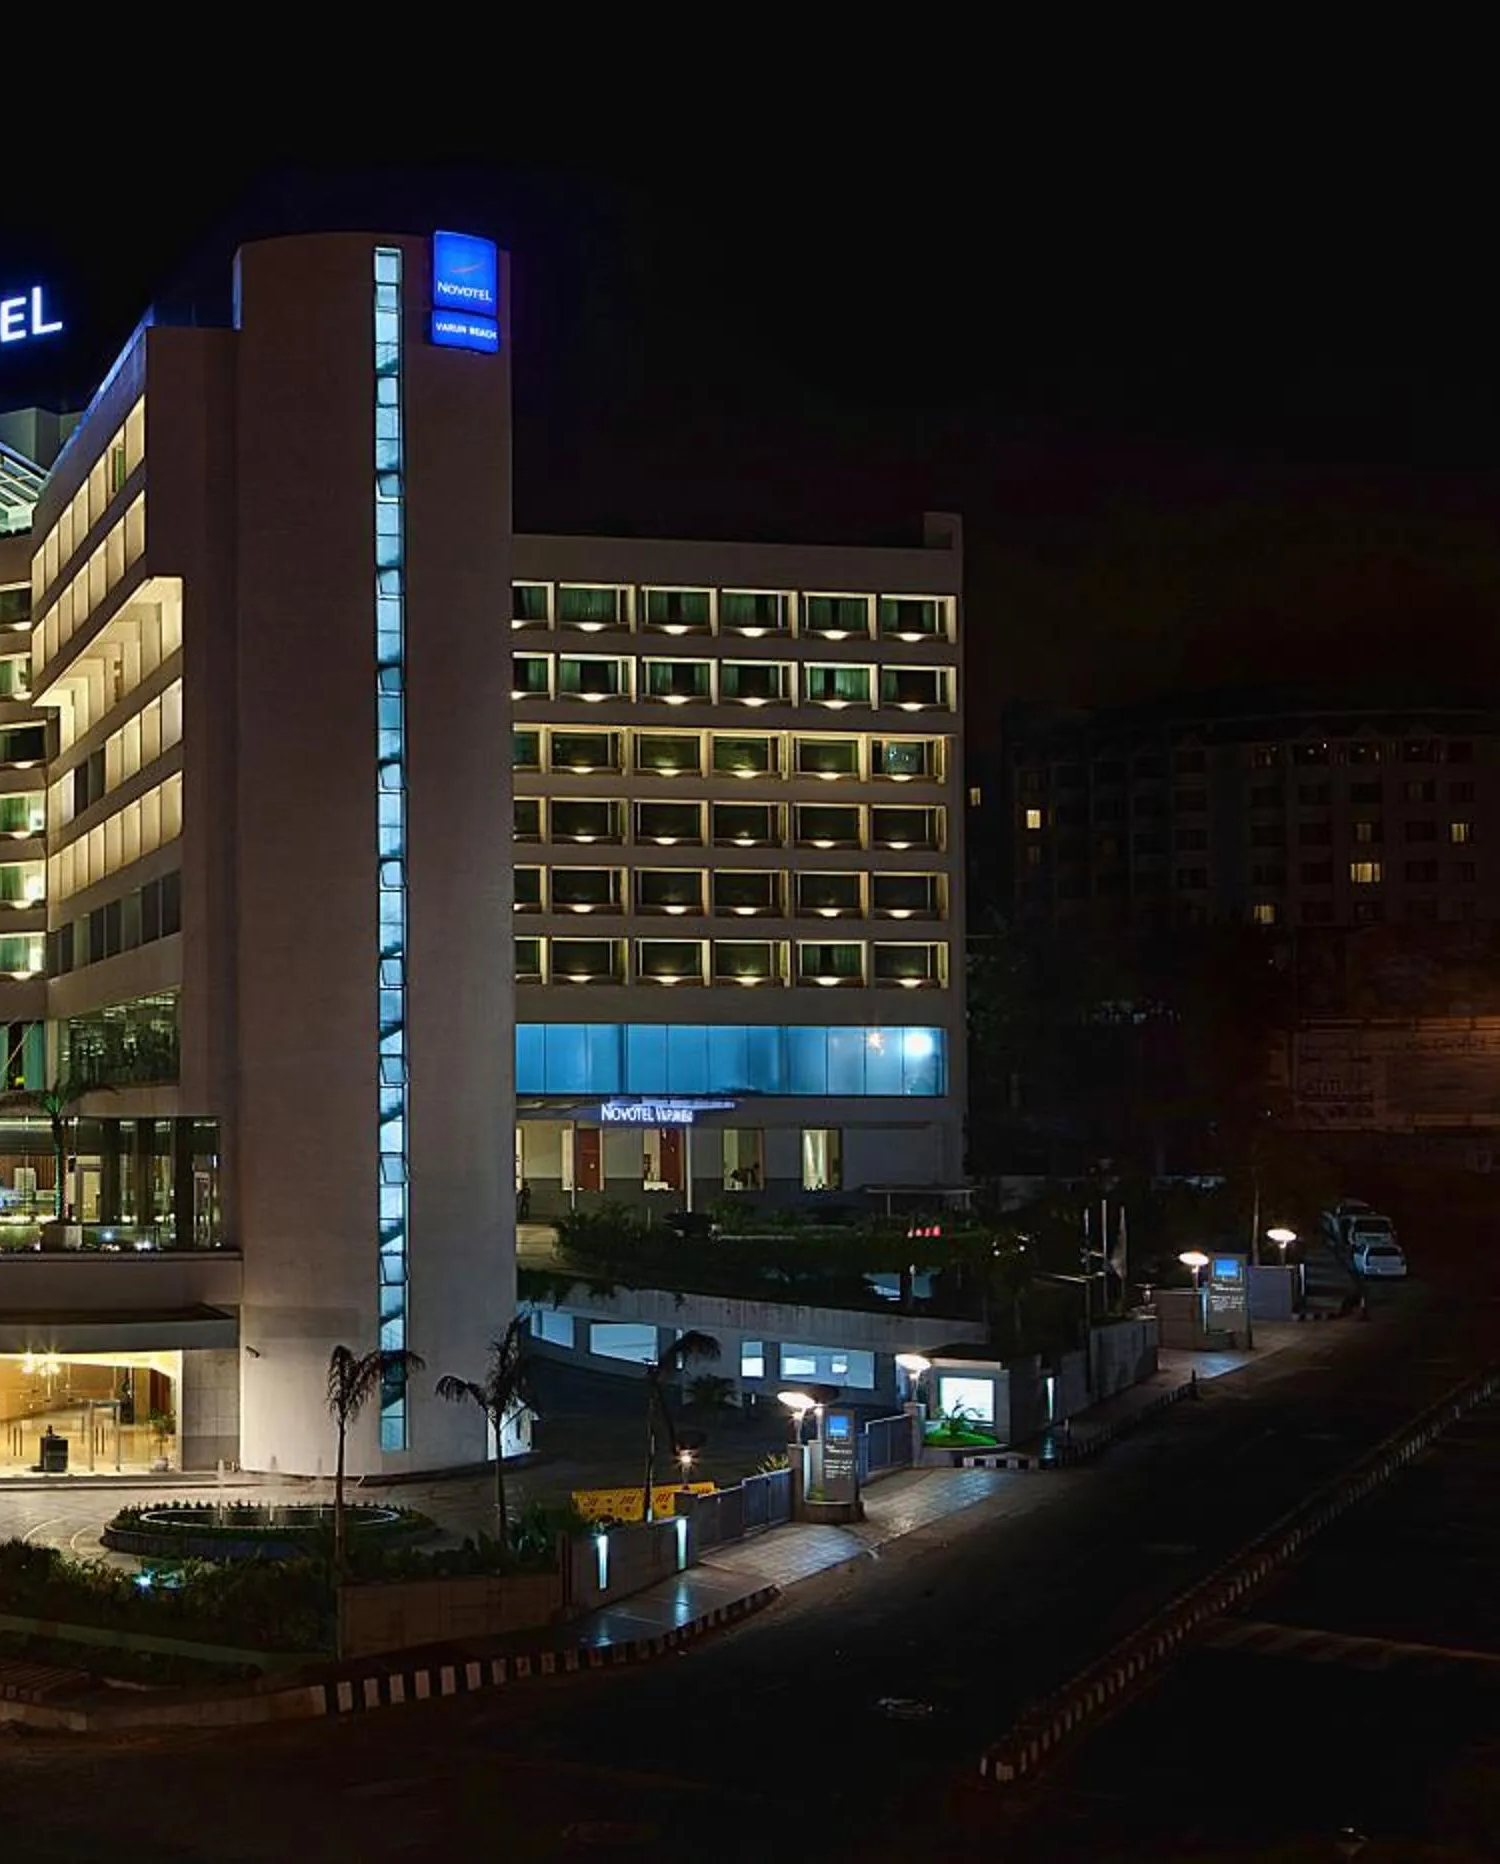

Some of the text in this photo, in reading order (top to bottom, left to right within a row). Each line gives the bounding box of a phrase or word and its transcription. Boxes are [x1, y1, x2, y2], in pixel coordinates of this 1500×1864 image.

[437, 280, 493, 303] NOVOTEL
[436, 322, 467, 334] VARUN
[601, 1103, 655, 1122] NOVOTEL
